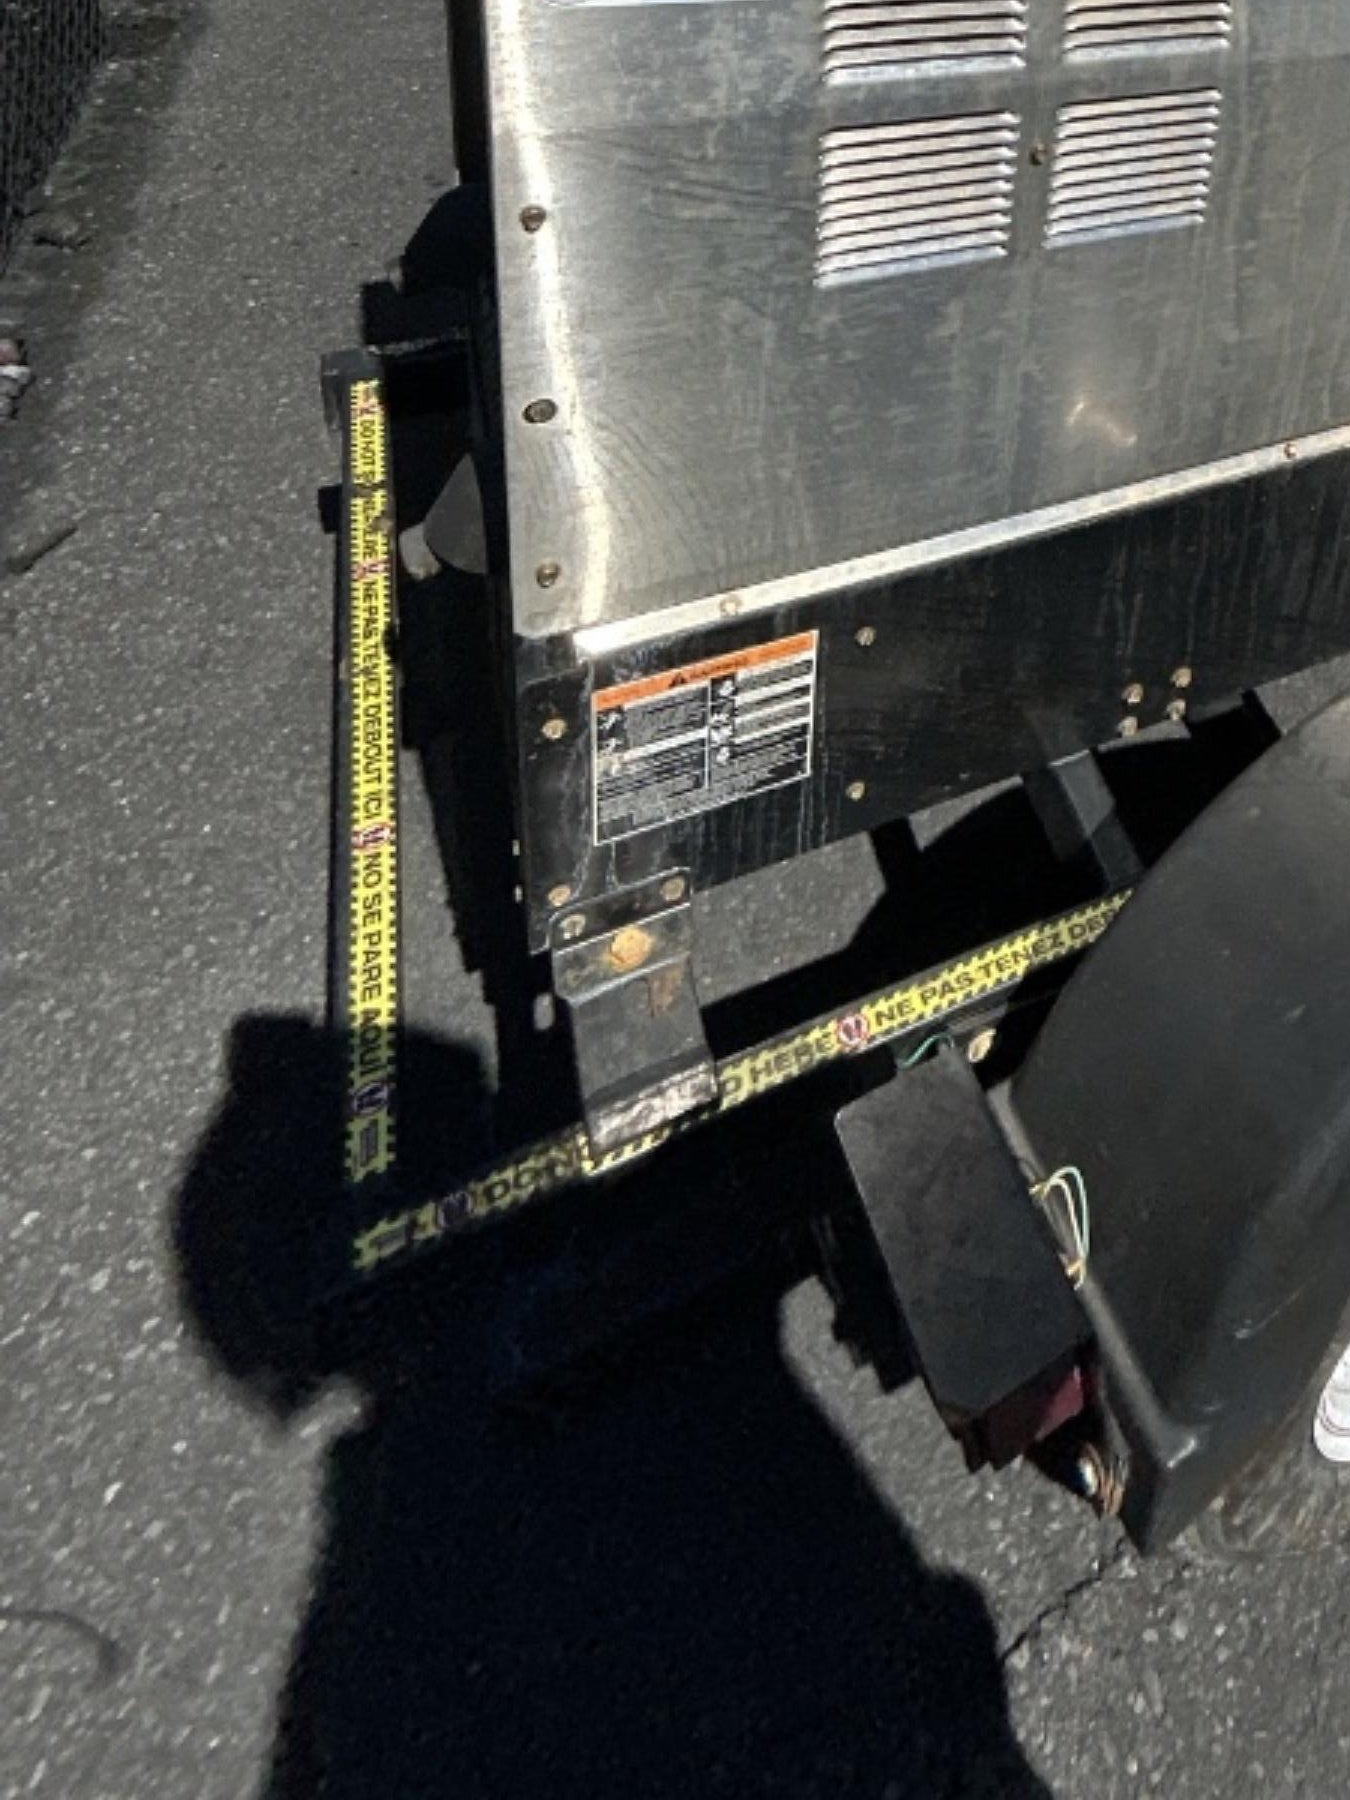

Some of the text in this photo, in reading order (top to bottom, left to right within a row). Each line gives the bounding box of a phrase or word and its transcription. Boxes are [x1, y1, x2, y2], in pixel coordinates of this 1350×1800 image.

[363, 703, 383, 786] DEBOUT
[363, 852, 383, 888] NO
[363, 892, 383, 927] SE
[362, 931, 382, 1002] PARE
[875, 999, 915, 1027] NE
[919, 972, 977, 1006] PAS
[980, 934, 1064, 978] TENEZ
